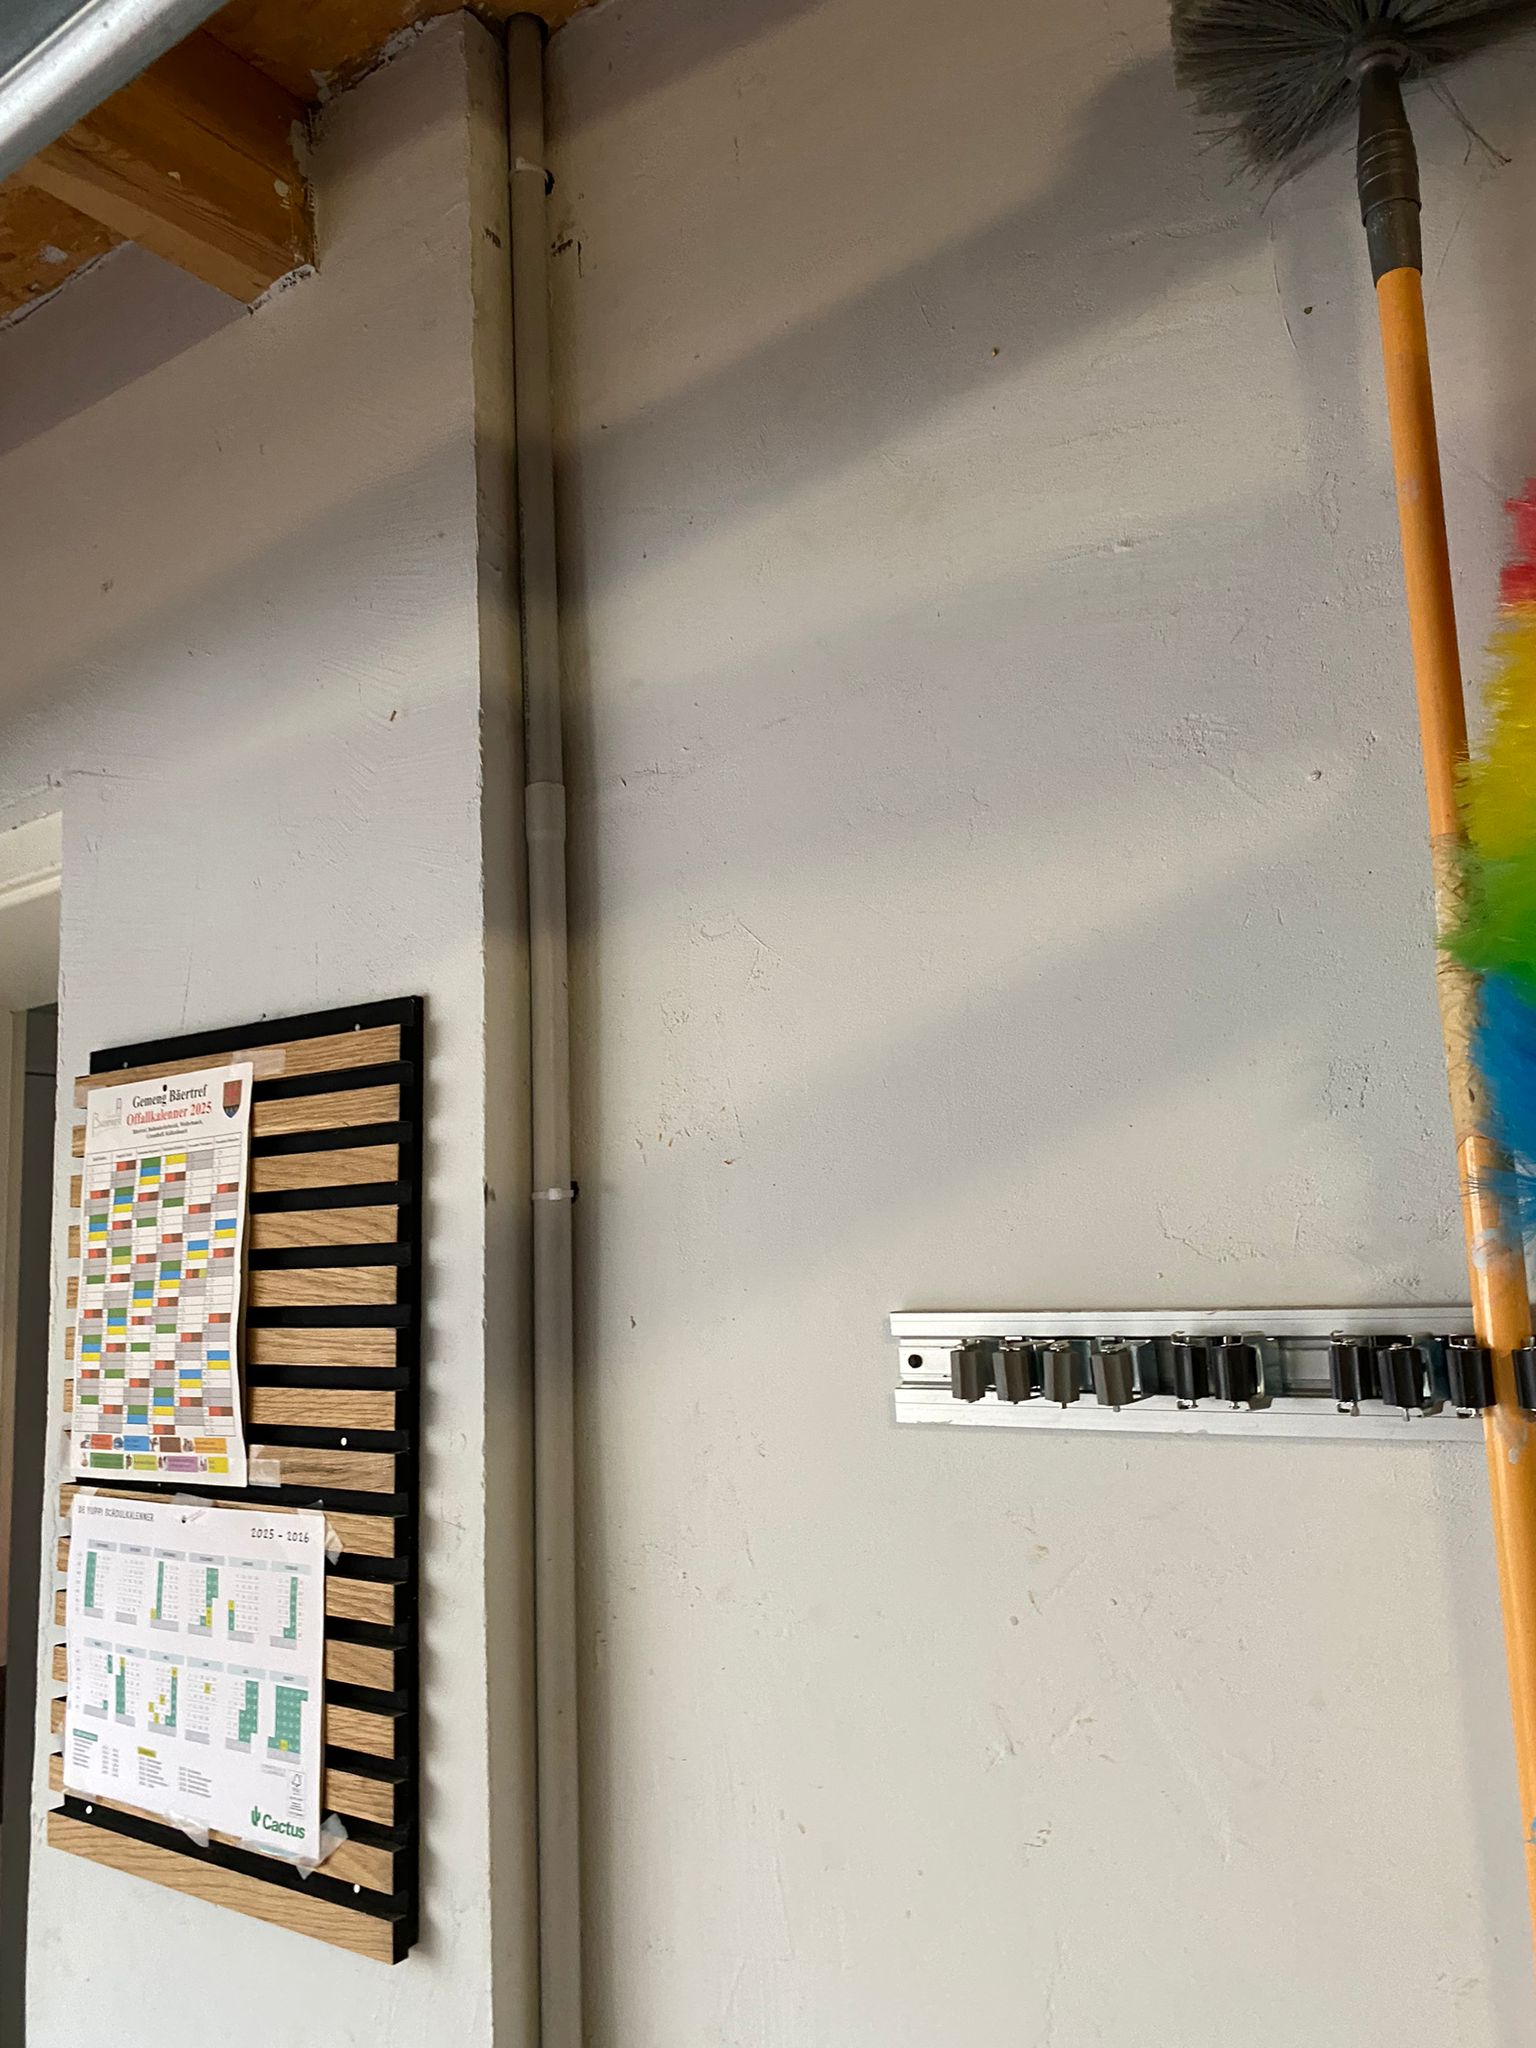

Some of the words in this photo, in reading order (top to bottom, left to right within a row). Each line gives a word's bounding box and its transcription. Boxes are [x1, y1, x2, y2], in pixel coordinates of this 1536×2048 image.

[132, 1094, 167, 1108] Gemeng
[169, 1084, 208, 1102] Bäertref
[127, 1108, 188, 1126] Offallkalenner
[190, 1101, 212, 1116] 2025
[251, 1527, 275, 1540] 2025
[287, 1531, 310, 1543] 2026
[262, 1813, 306, 1839] Cactus
